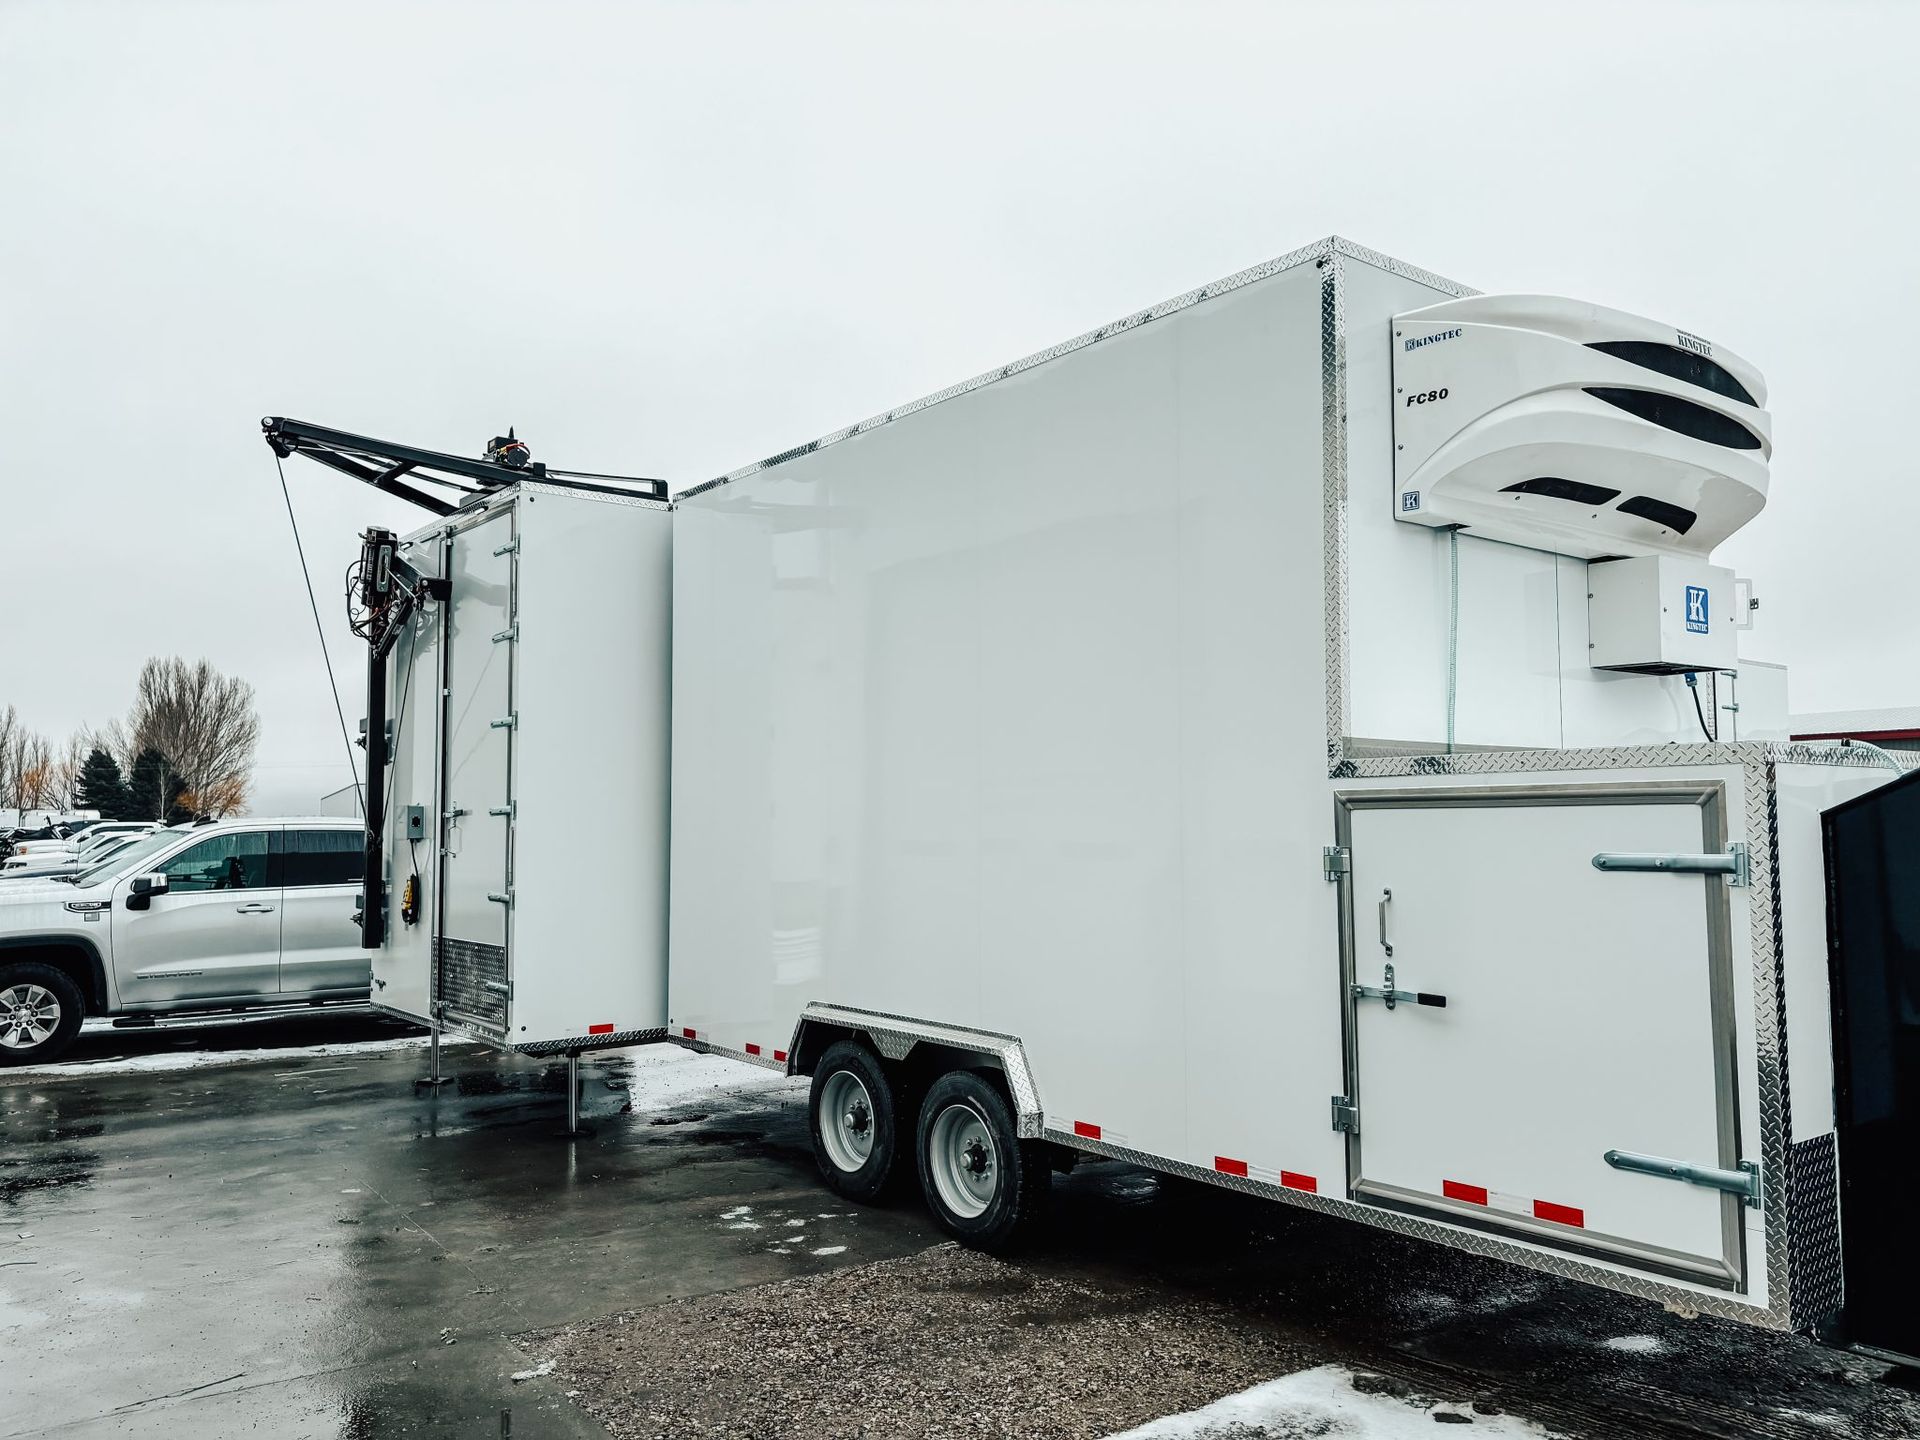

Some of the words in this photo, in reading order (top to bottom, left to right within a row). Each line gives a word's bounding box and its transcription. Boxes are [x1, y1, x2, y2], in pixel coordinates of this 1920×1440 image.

[1416, 328, 1462, 348] KINGTEC
[1677, 334, 1712, 357] KINGTEC
[1406, 388, 1449, 407] FC80
[1405, 493, 1418, 508] K
[1689, 589, 1706, 622] K
